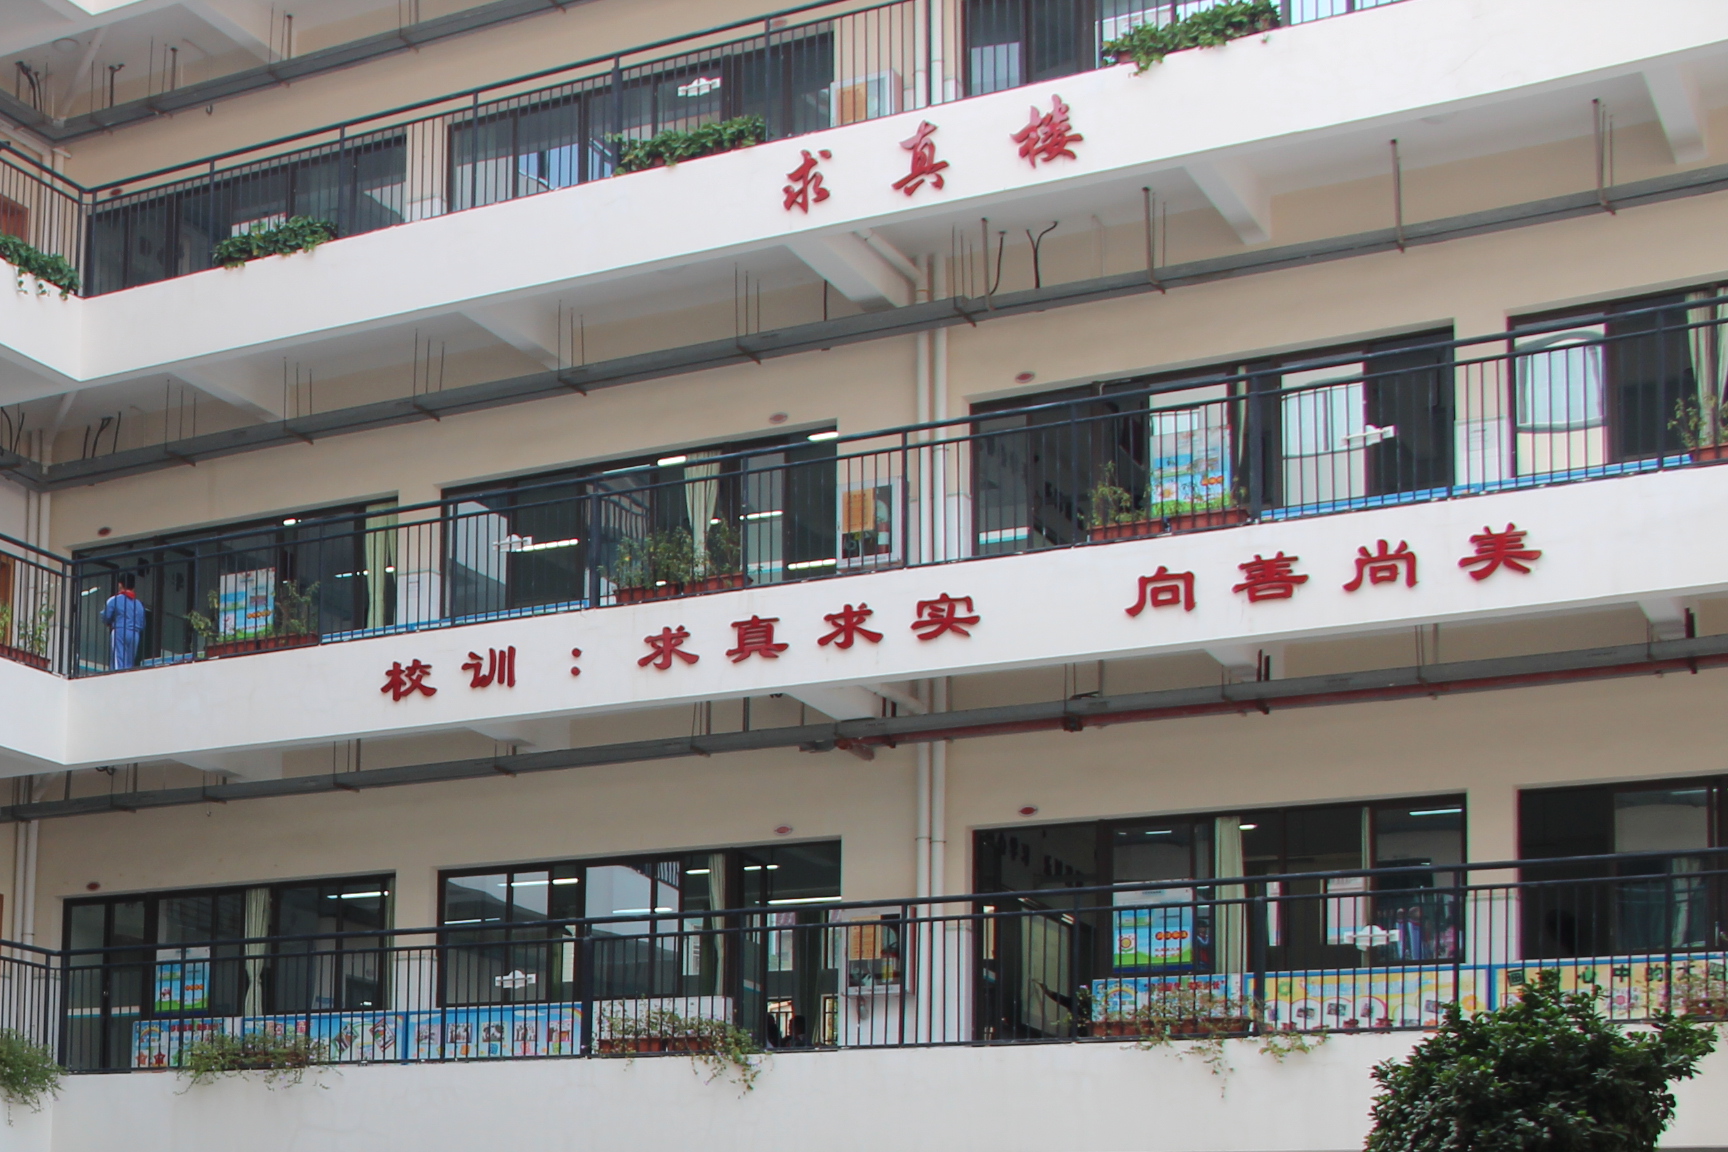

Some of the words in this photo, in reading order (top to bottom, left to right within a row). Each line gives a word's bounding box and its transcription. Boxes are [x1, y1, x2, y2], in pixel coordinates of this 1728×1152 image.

[782, 94, 1084, 214] 求真楼
[1125, 523, 1541, 618] 向善尚美
